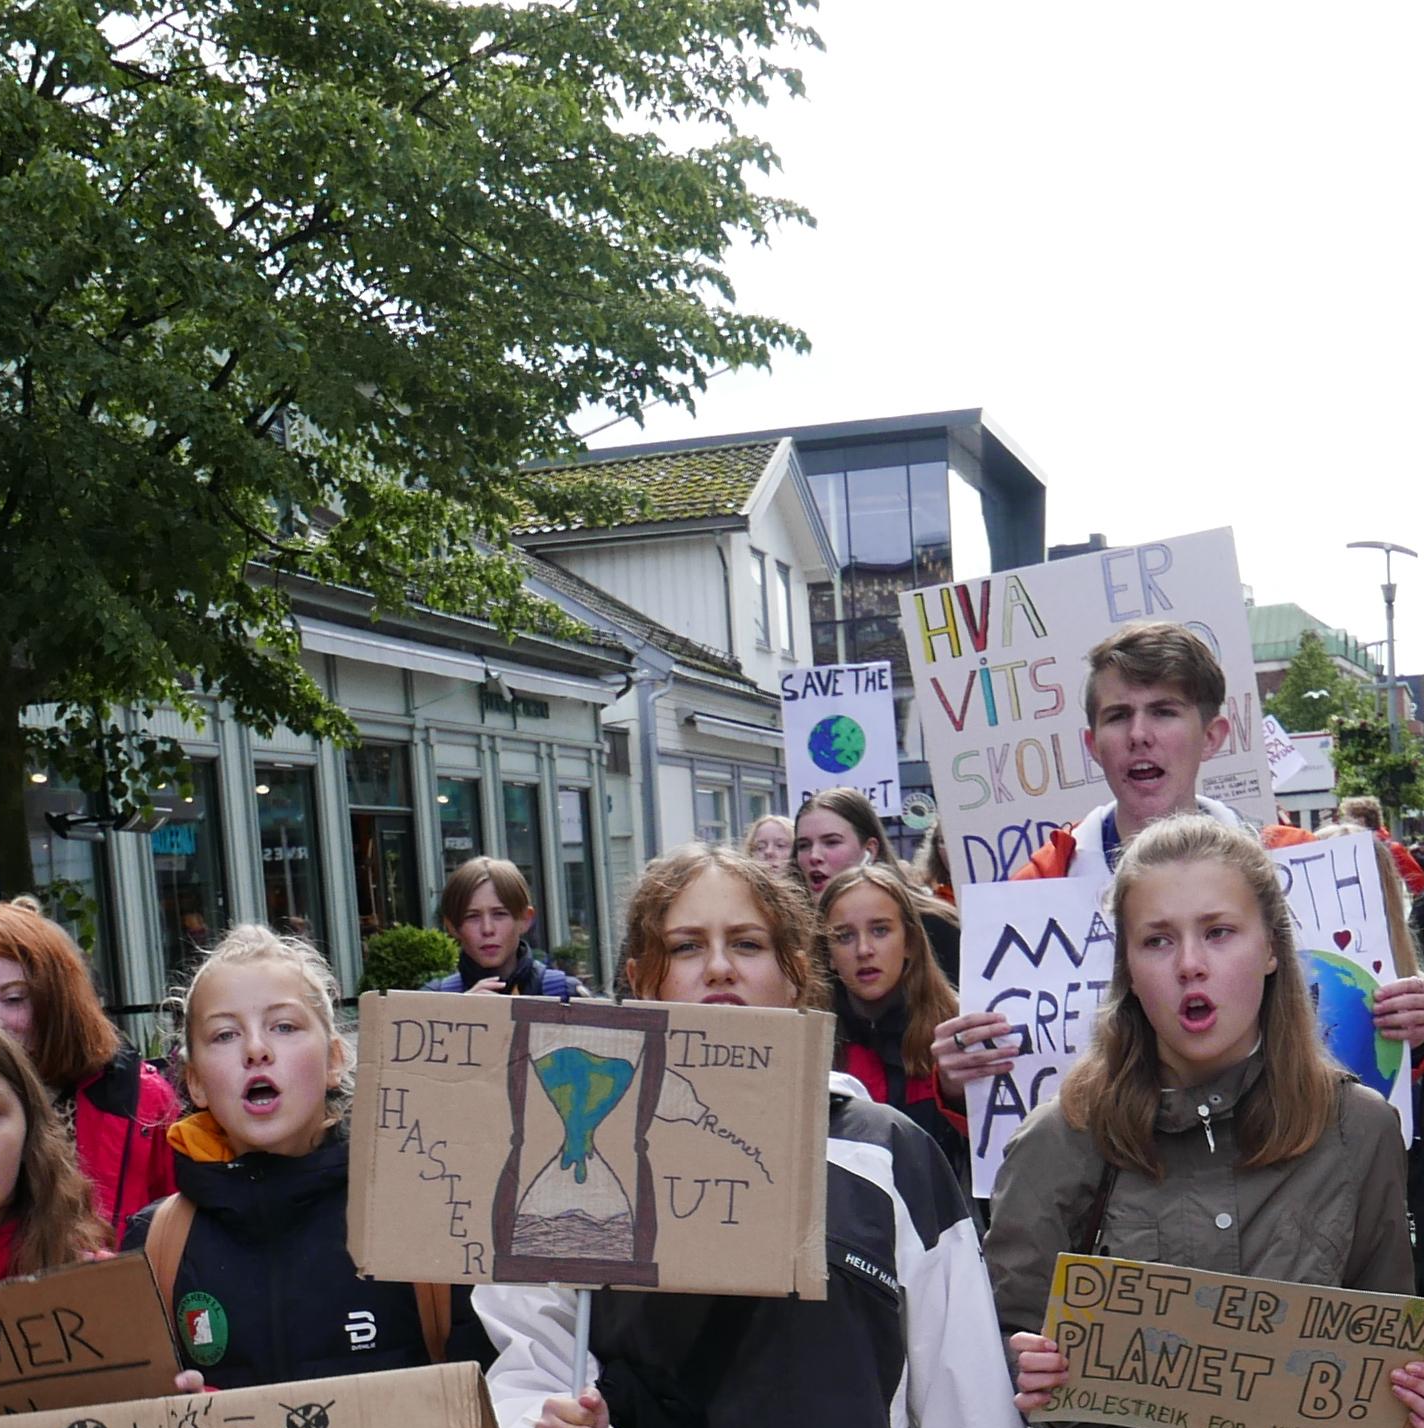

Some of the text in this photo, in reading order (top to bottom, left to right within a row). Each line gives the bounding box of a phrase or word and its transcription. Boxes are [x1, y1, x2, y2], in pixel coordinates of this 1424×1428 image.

[913, 543, 1174, 664] HVA ER
[781, 667, 889, 701] SAVE THE
[390, 1019, 488, 1067] DET
[702, 1114, 766, 1168] Renner
[378, 1088, 487, 1275] HASTER
[664, 1176, 749, 1225] UT
[845, 1252, 878, 1276] HELLY
[1064, 1263, 1191, 1316] DET
[1212, 1284, 1280, 1335] ER
[1055, 1321, 1384, 1420] PLANET B!
